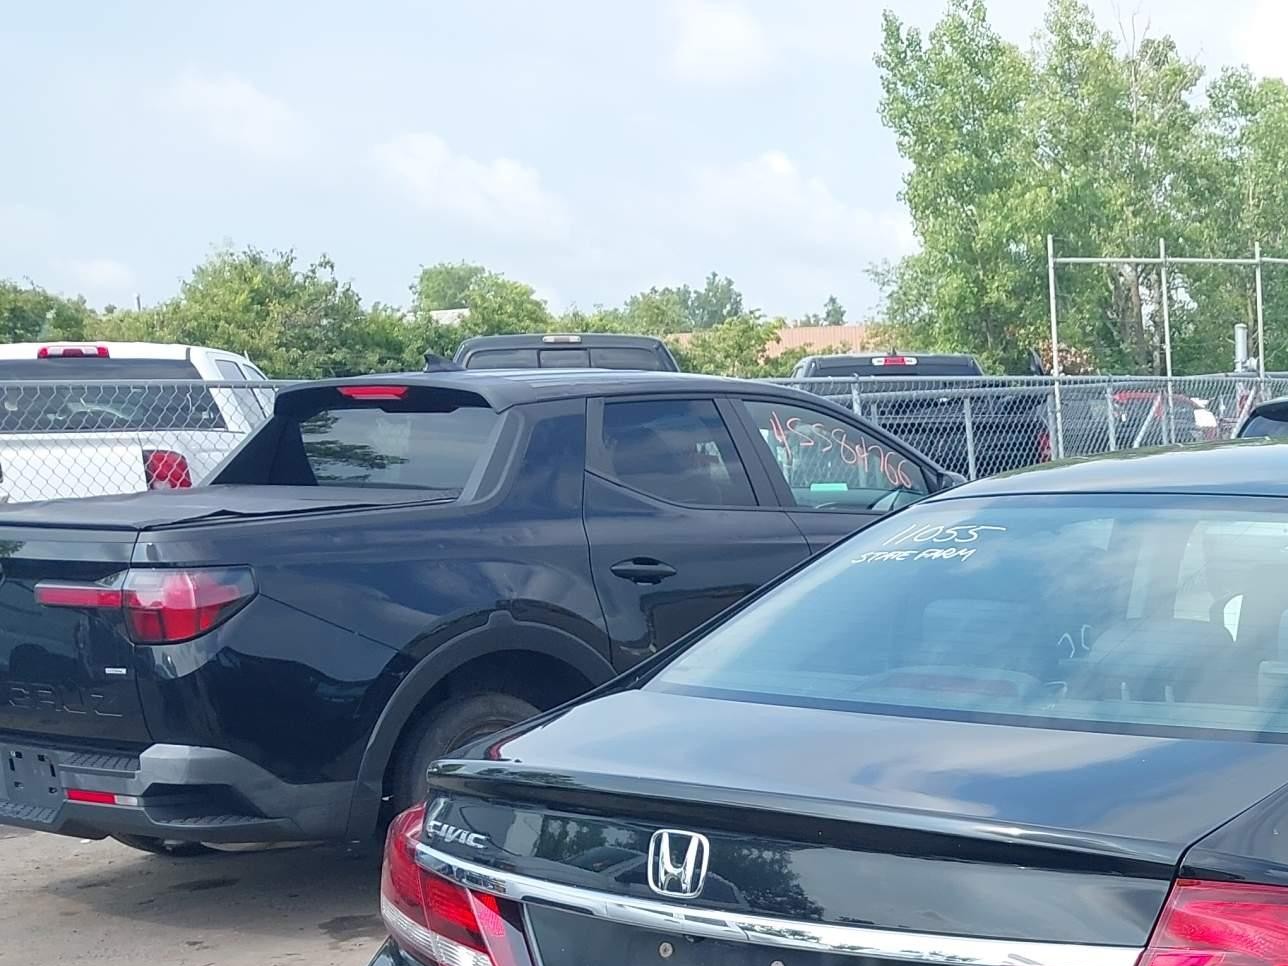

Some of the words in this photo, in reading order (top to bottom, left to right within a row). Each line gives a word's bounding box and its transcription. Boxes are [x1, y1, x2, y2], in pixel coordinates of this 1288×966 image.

[769, 410, 912, 489] 45584766
[882, 523, 1007, 546] 11055
[851, 549, 919, 564] STATE
[914, 547, 977, 562] FARM
[427, 820, 490, 849] CIVIC
